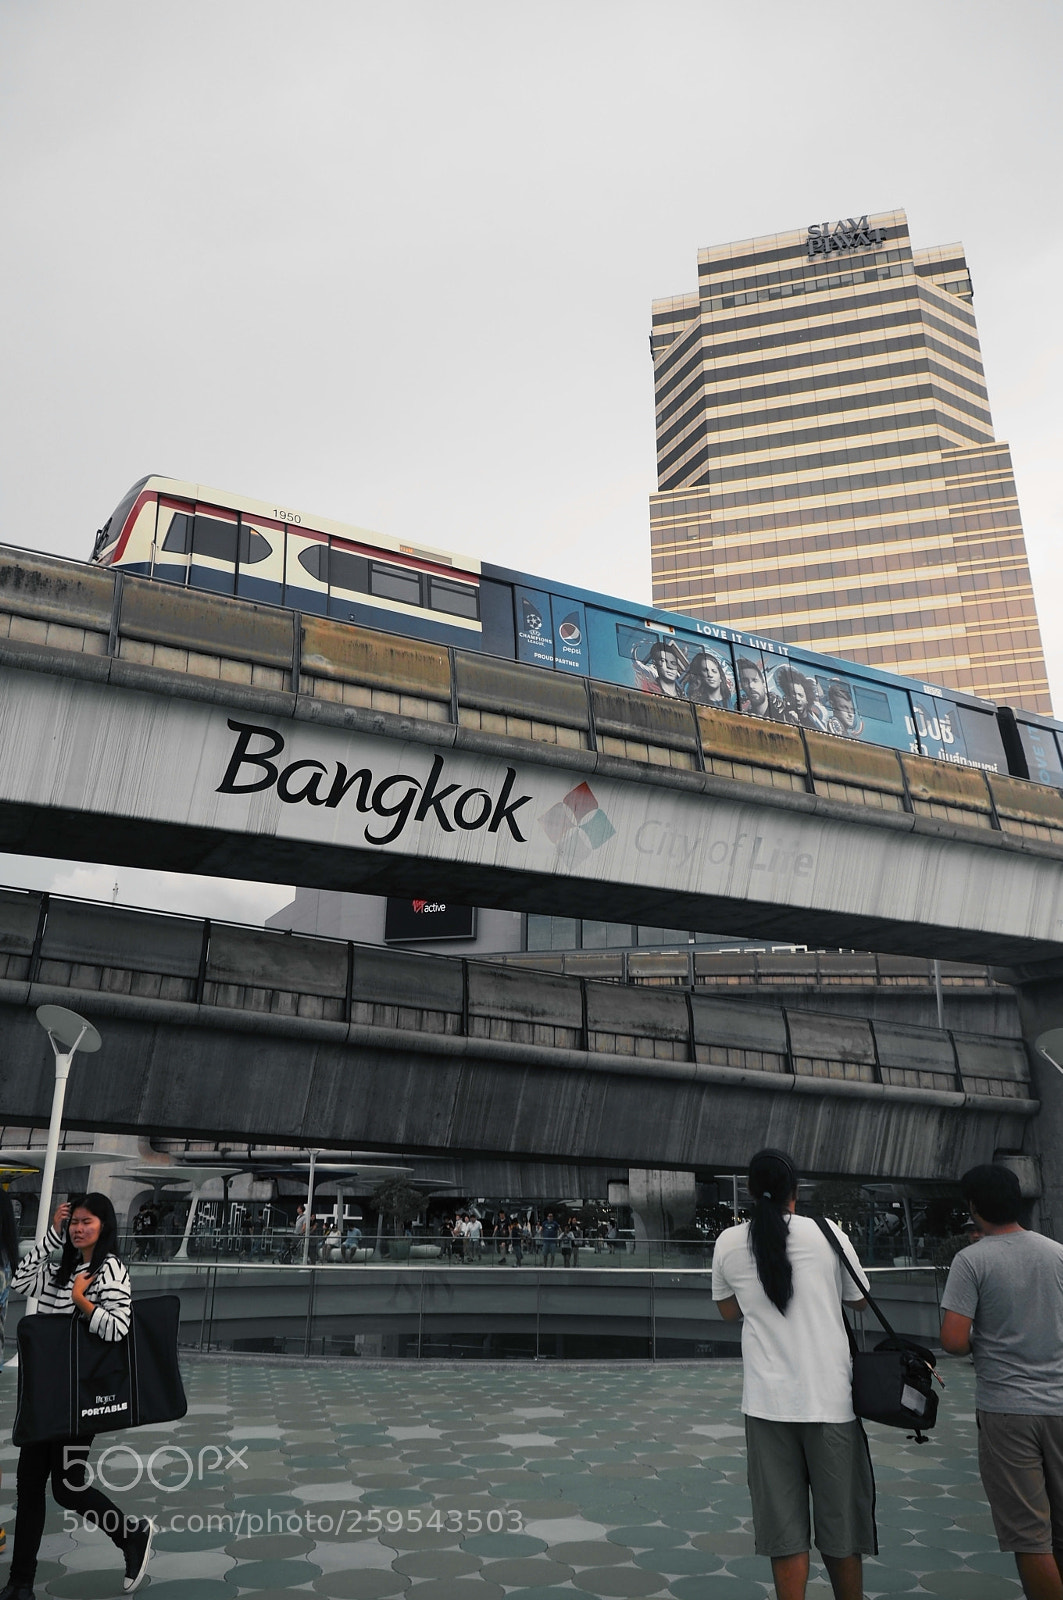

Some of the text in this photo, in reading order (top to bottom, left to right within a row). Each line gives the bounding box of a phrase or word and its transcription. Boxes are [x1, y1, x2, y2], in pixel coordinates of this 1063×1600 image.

[807, 215, 869, 239] SIAM
[807, 227, 887, 256] PIWAT
[272, 508, 302, 524] 1950
[518, 632, 553, 644] CHAMPIONS
[696, 623, 789, 656] LOVE IT LIVE IT
[533, 652, 580, 668] PROUD PARTNER
[562, 646, 582, 655] pepsi
[1032, 745, 1051, 784] OVE
[215, 718, 533, 845] Bangkok
[634, 820, 697, 868] City
[707, 832, 748, 867] of
[424, 902, 446, 913] active
[81, 1402, 128, 1417] PORTABLE
